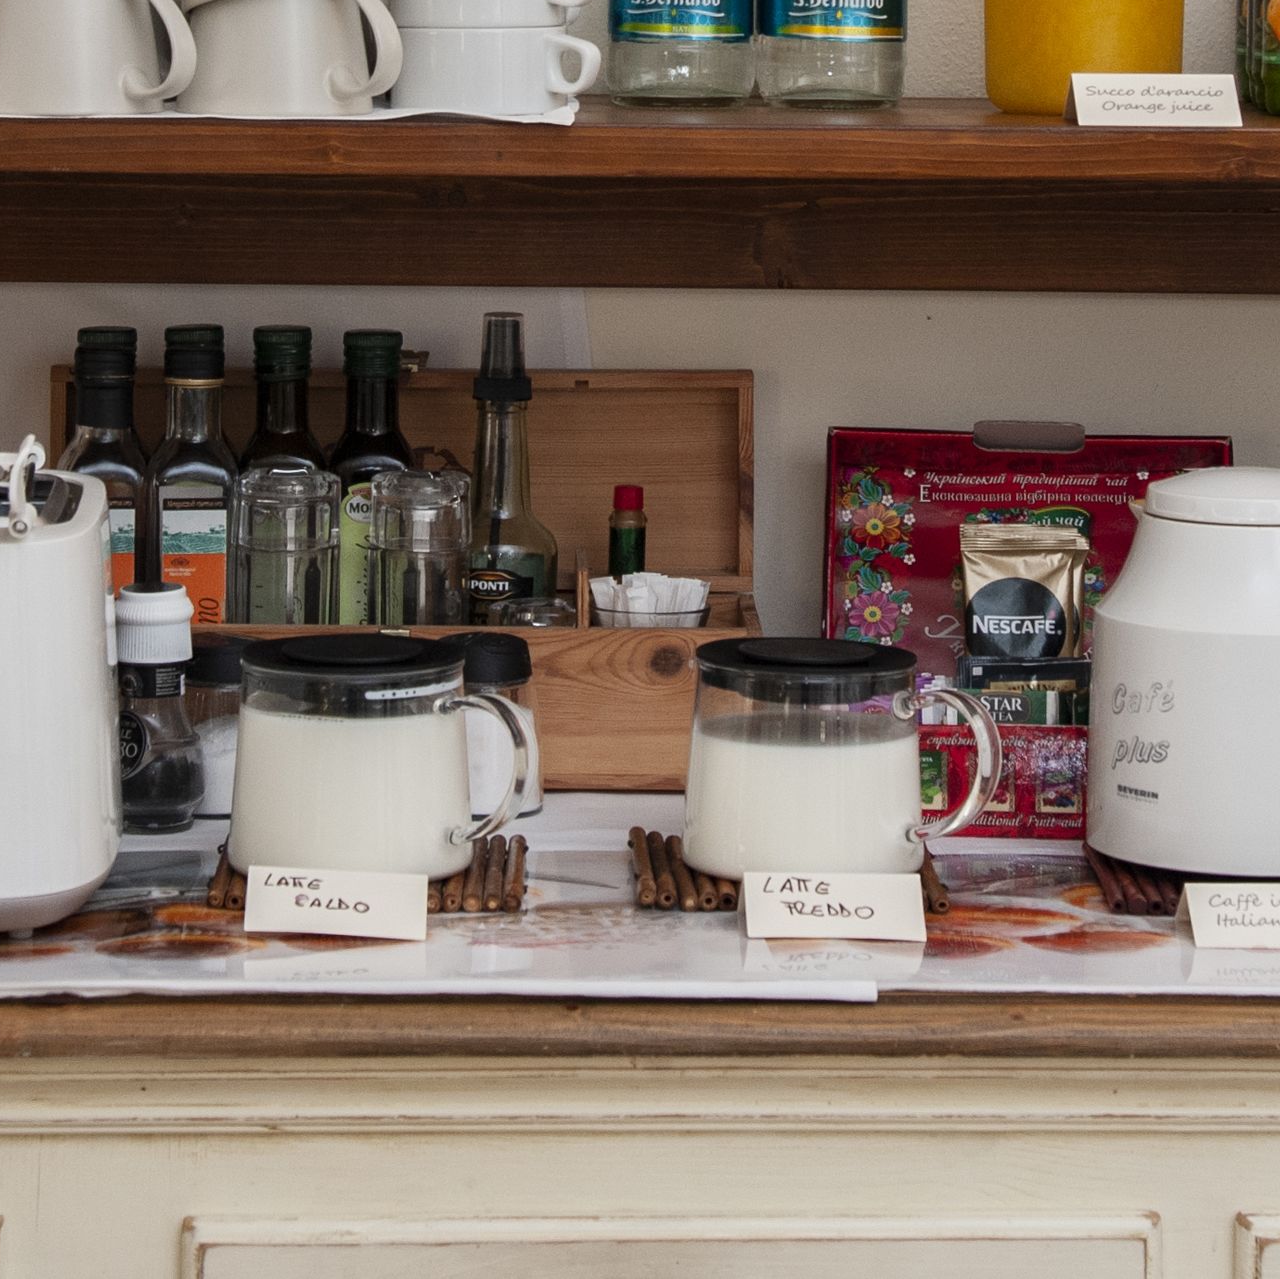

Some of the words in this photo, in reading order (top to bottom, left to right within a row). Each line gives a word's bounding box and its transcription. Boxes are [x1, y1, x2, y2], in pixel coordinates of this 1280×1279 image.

[1085, 85, 1135, 97] Succo
[1140, 86, 1224, 98] d'arancio
[1102, 100, 1166, 114] Orange
[1170, 102, 1214, 114] juice
[924, 472, 1007, 489] Український
[1105, 477, 1129, 487] чай
[471, 580, 510, 592] PONTI
[981, 696, 1023, 712] STAR
[1111, 735, 1170, 770] plus
[1117, 784, 1159, 800] SEVERIN
[264, 873, 323, 890] LATTE
[763, 876, 831, 895] LATTE
[1208, 893, 1263, 908] Caffè
[780, 900, 875, 920] FREDDO
